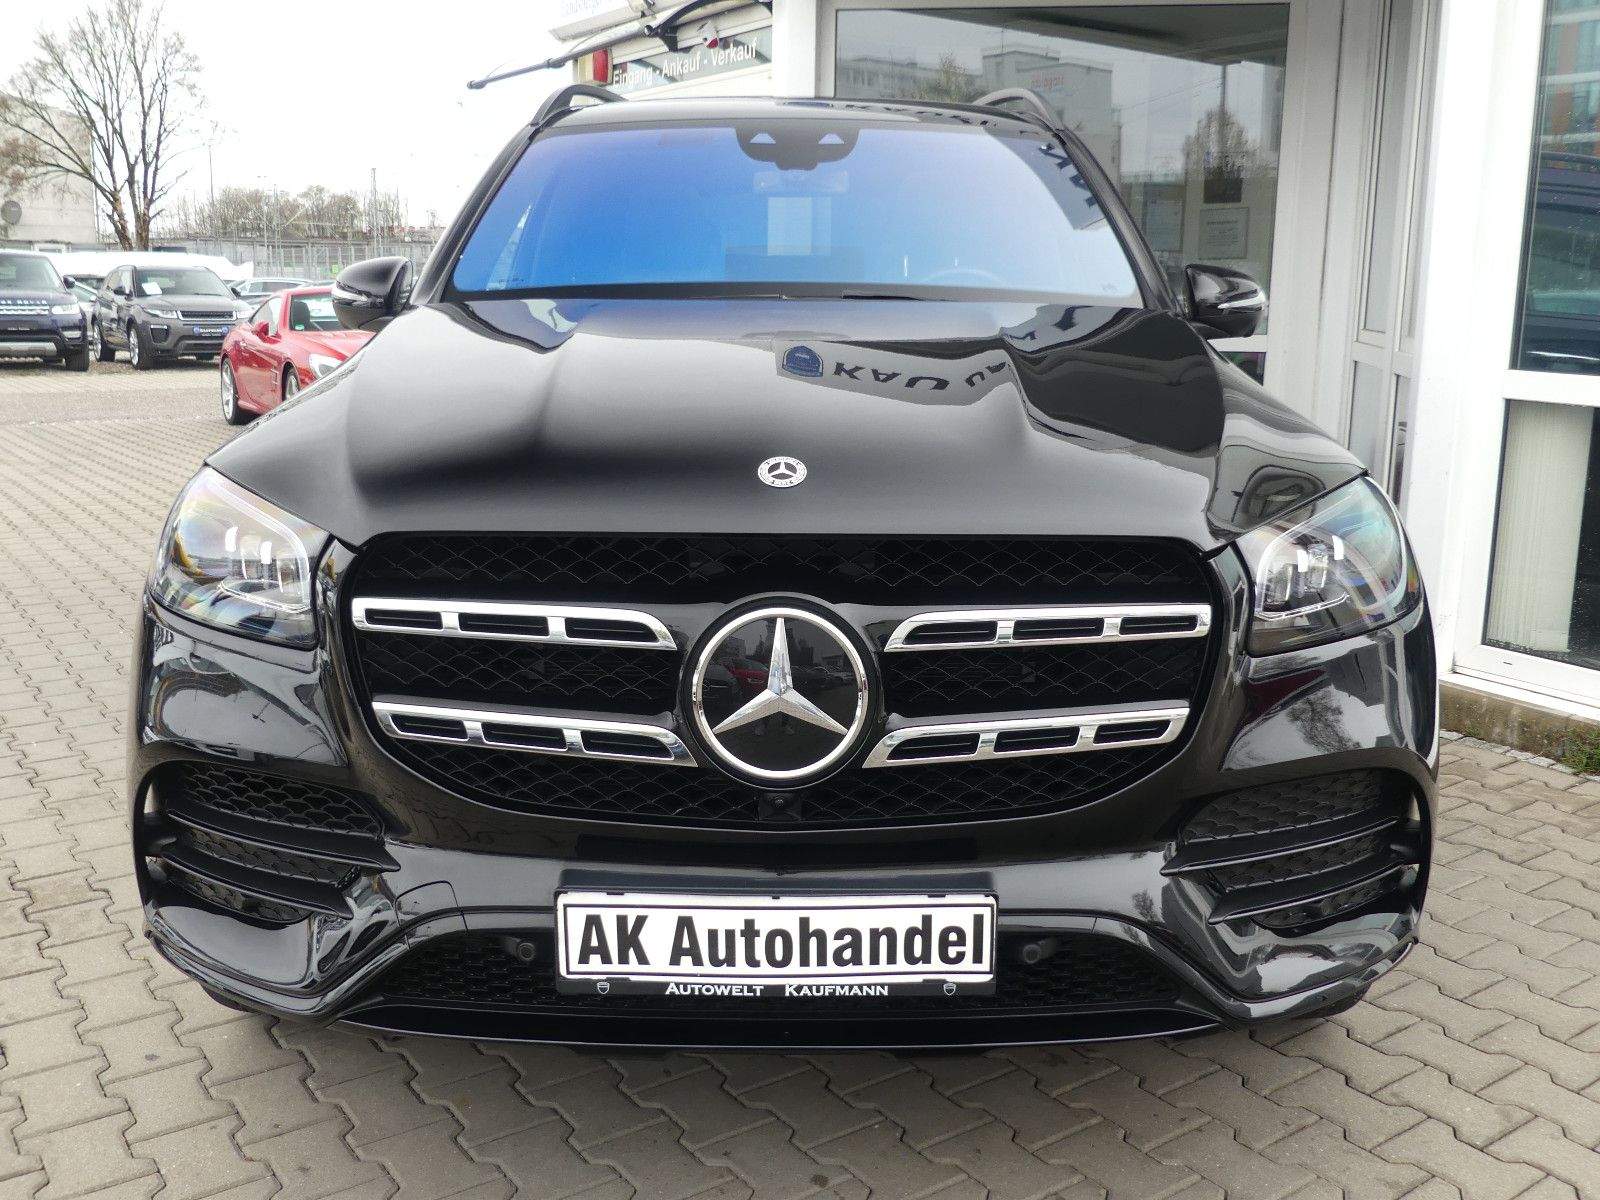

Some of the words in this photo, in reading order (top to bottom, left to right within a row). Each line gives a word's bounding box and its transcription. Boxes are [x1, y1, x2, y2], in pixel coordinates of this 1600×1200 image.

[613, 65, 653, 88] Eingang
[661, 53, 702, 79] Ankauf
[710, 37, 758, 67] Verkauf
[577, 914, 650, 966] AK
[669, 913, 985, 969] Autohandel
[665, 982, 764, 996] AUTOWELT
[785, 983, 889, 997] KAUFMANN
